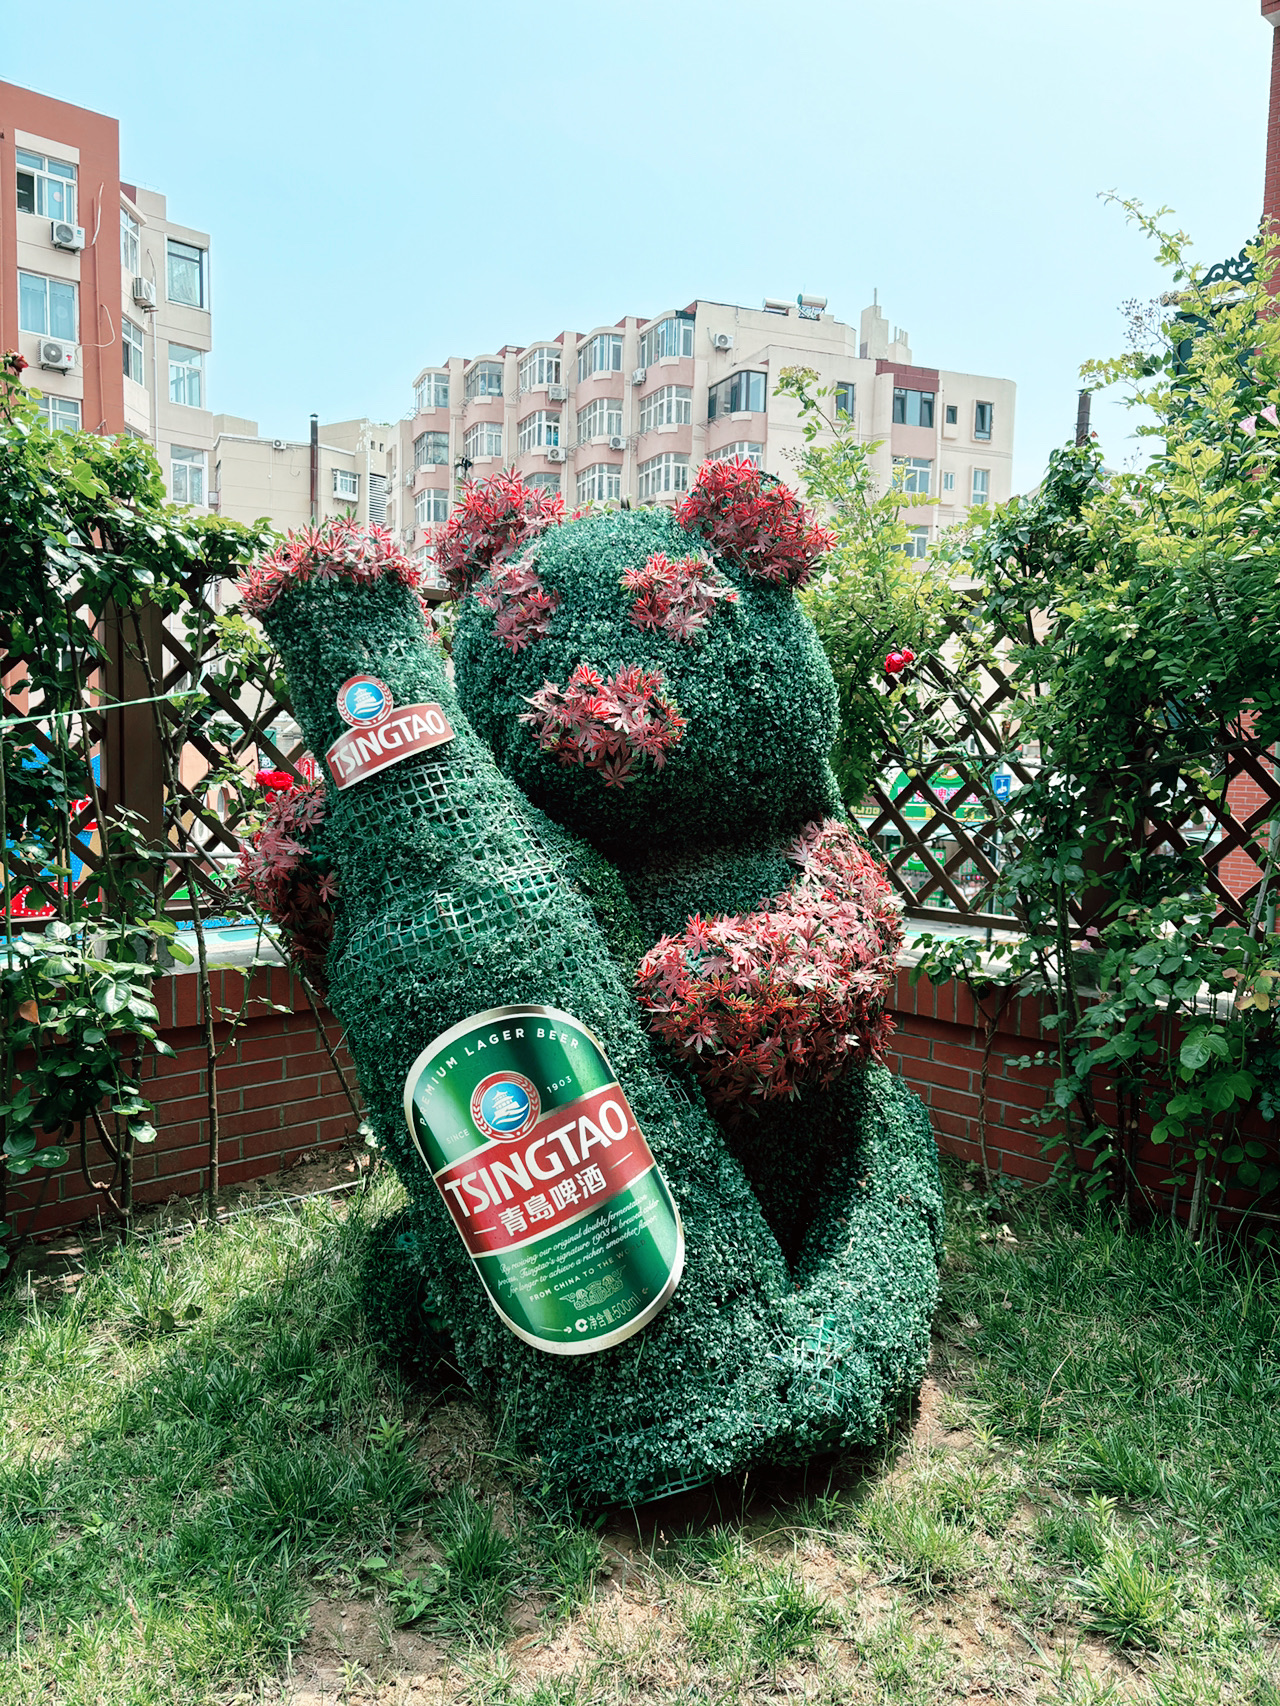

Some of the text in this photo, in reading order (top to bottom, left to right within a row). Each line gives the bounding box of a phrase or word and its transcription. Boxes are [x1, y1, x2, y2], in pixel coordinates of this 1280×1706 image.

[331, 709, 446, 779] TSINGTAO
[419, 1028, 579, 1126] PREMIUM LAGER BEER
[446, 1075, 573, 1145] SINCE 1903
[444, 1100, 629, 1218] TSINGTAO
[498, 1163, 607, 1237] 青島啤酒
[500, 1194, 648, 1275] By reviving our original double fermentation
[519, 1280, 539, 1292] longer
[539, 1274, 549, 1283] to
[549, 1265, 575, 1279] achieve
[583, 1247, 605, 1262] richer,
[606, 1227, 638, 1249] smoother
[520, 1257, 556, 1279] Tsingtao's
[556, 1240, 590, 1263] signature
[592, 1227, 610, 1245] 1903
[611, 1224, 618, 1234] is
[618, 1206, 642, 1229] brewed
[529, 1288, 552, 1302] FROM
[553, 1276, 581, 1291] CHINA
[582, 1267, 595, 1277] TO
[597, 1257, 614, 1269] THE
